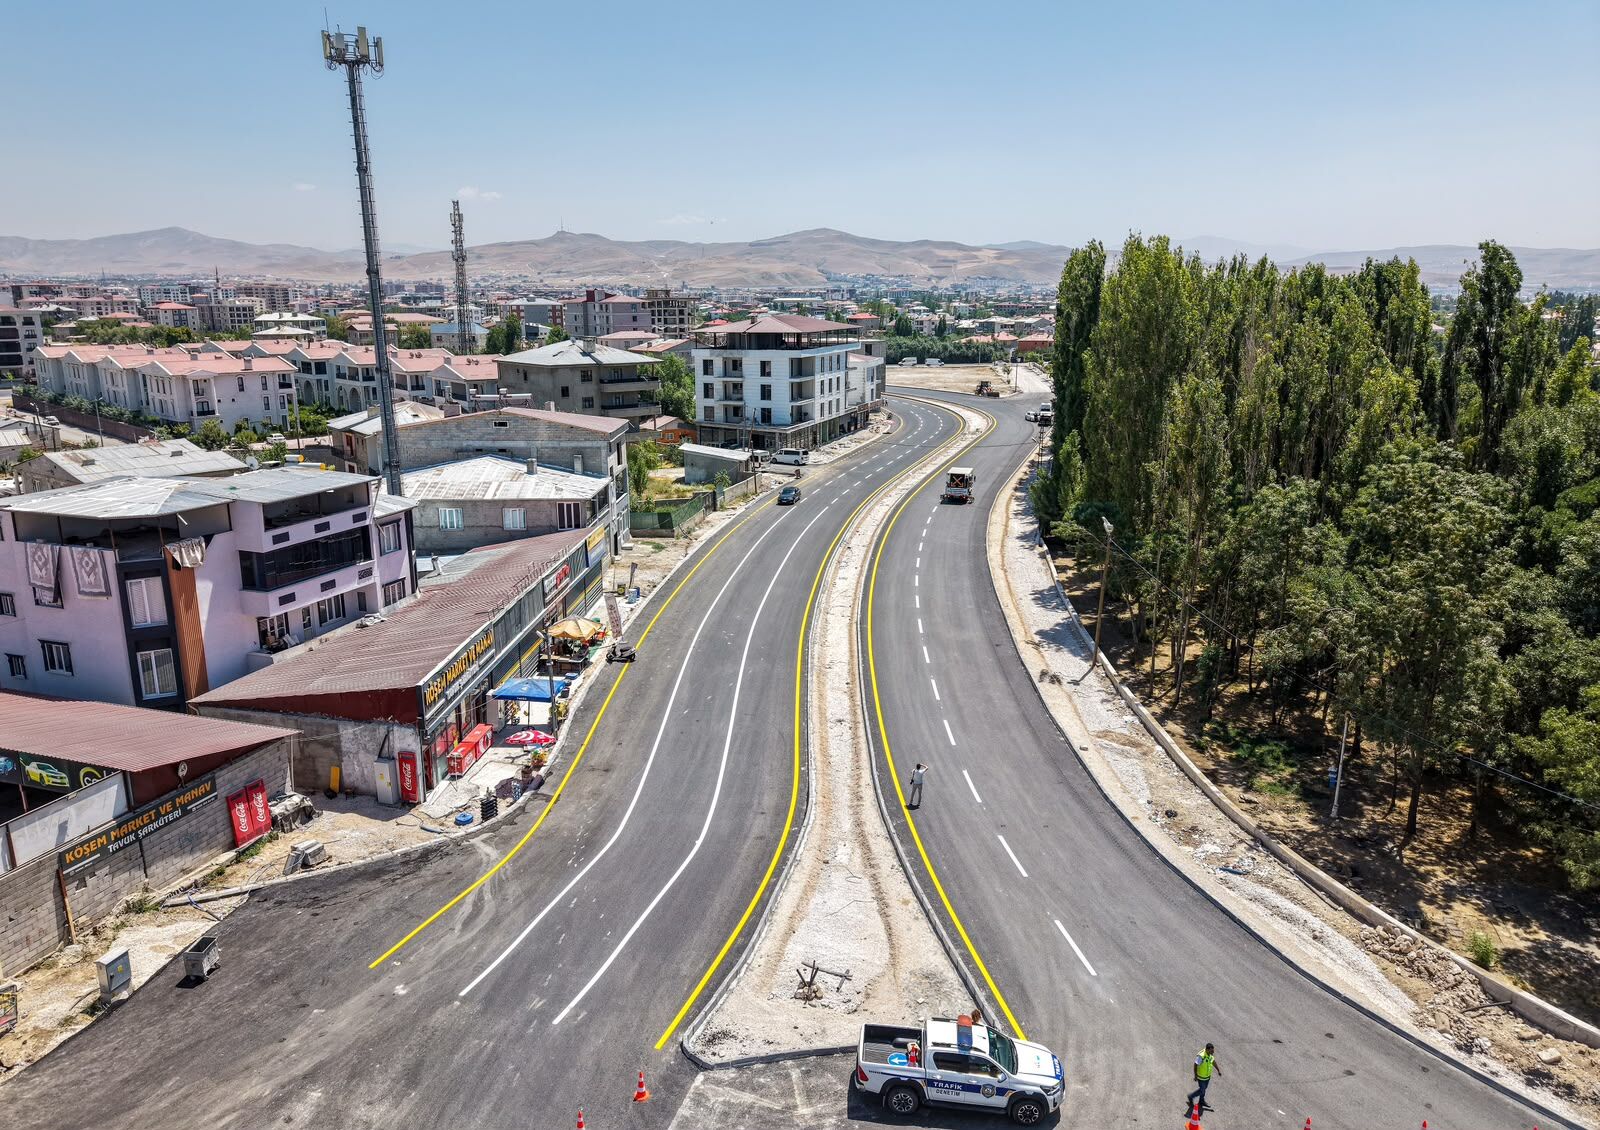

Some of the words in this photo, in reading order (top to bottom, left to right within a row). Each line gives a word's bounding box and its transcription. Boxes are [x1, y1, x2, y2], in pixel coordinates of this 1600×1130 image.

[65, 835, 108, 864] KÖŞEM
[110, 809, 157, 841] MARKET
[159, 801, 174, 815] VE
[175, 781, 212, 808] MANAV
[107, 833, 137, 853] TAVUK
[138, 808, 182, 839] ŞARKÜTERİ
[933, 1081, 963, 1091] TRAFİK
